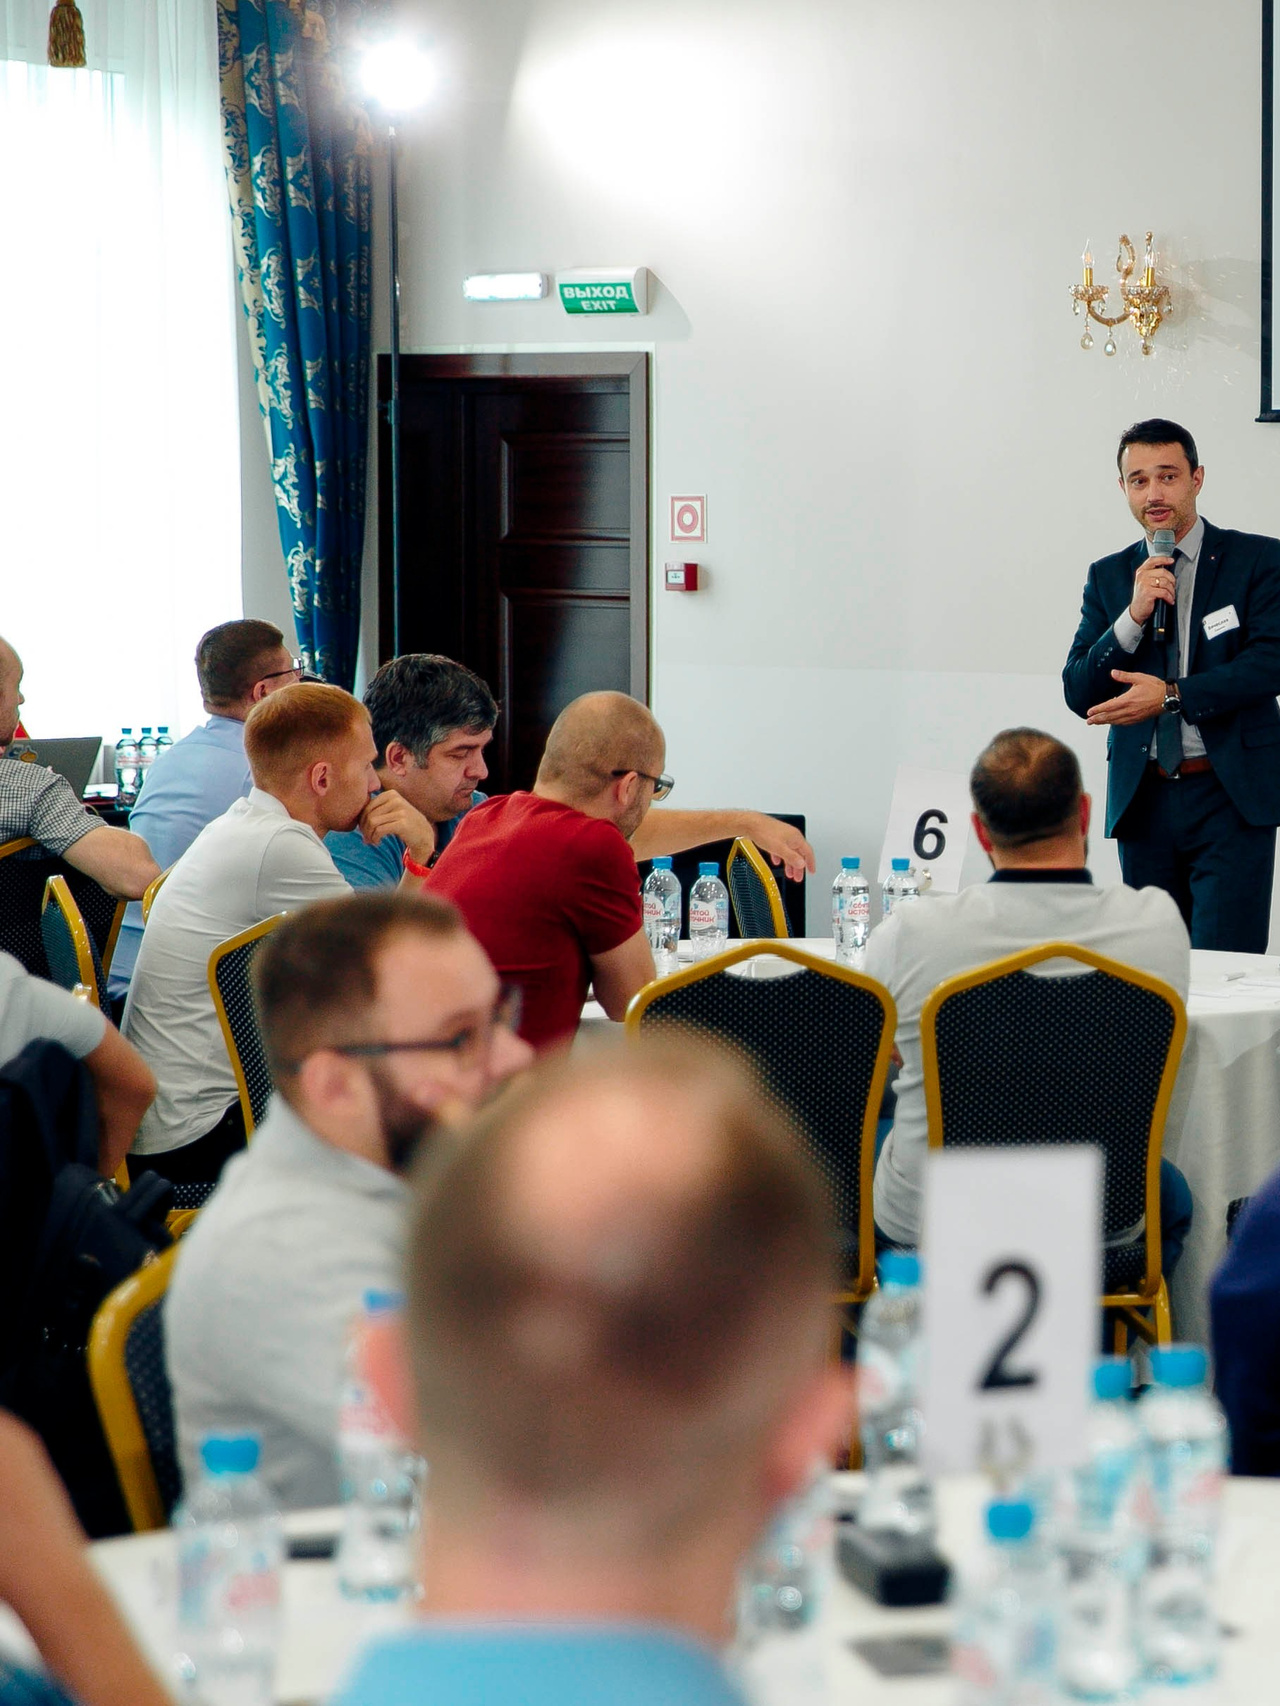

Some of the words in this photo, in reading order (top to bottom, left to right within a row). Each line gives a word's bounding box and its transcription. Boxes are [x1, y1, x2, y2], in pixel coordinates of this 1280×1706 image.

[563, 286, 629, 299] ВЫХОД
[581, 300, 616, 311] EXIT
[913, 808, 948, 860] 6
[977, 1260, 1042, 1389] 2
